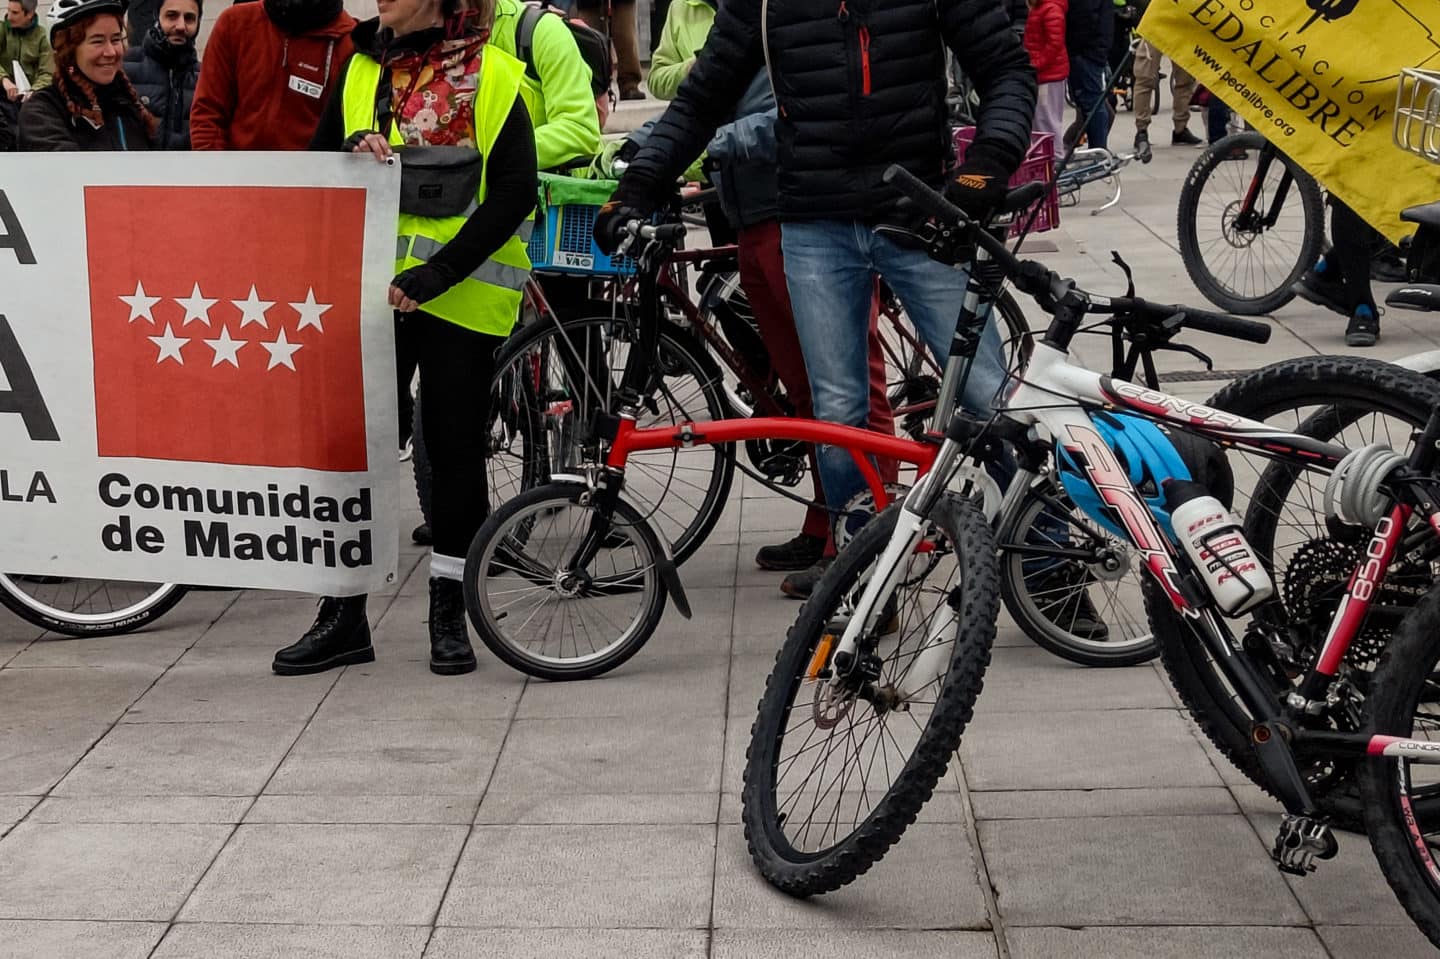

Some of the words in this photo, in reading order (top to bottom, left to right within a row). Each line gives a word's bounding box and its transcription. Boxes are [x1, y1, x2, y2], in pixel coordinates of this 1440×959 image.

[1192, 43, 1297, 137] www.pedalibre.org
[1, 470, 57, 503] LA
[98, 472, 374, 523] Comunidad
[101, 516, 165, 554] de
[183, 519, 374, 569] Madrid
[1352, 517, 1394, 601] 8500
